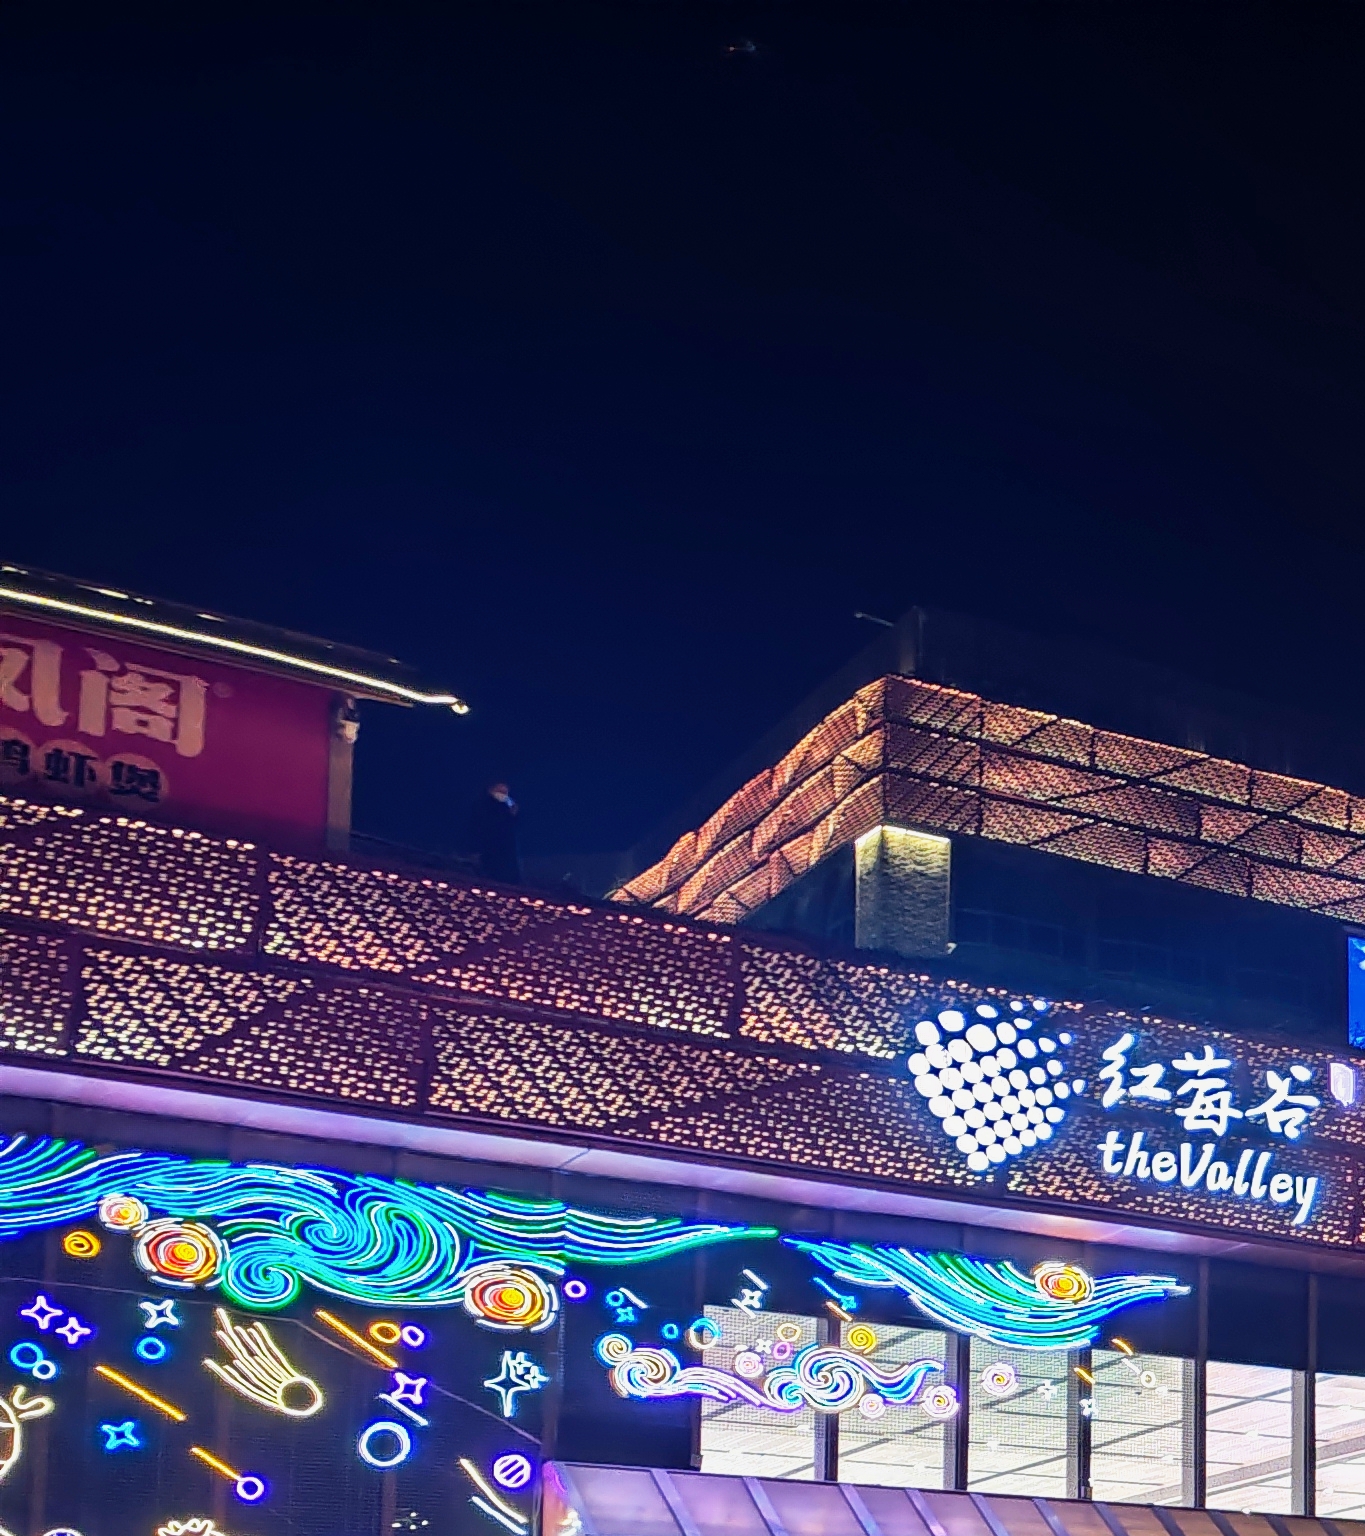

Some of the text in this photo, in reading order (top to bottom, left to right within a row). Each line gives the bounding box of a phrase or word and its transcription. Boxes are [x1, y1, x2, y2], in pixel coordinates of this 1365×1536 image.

[1099, 1033, 1321, 1139] 红莓谷
[1096, 1130, 1319, 1226] theValley
